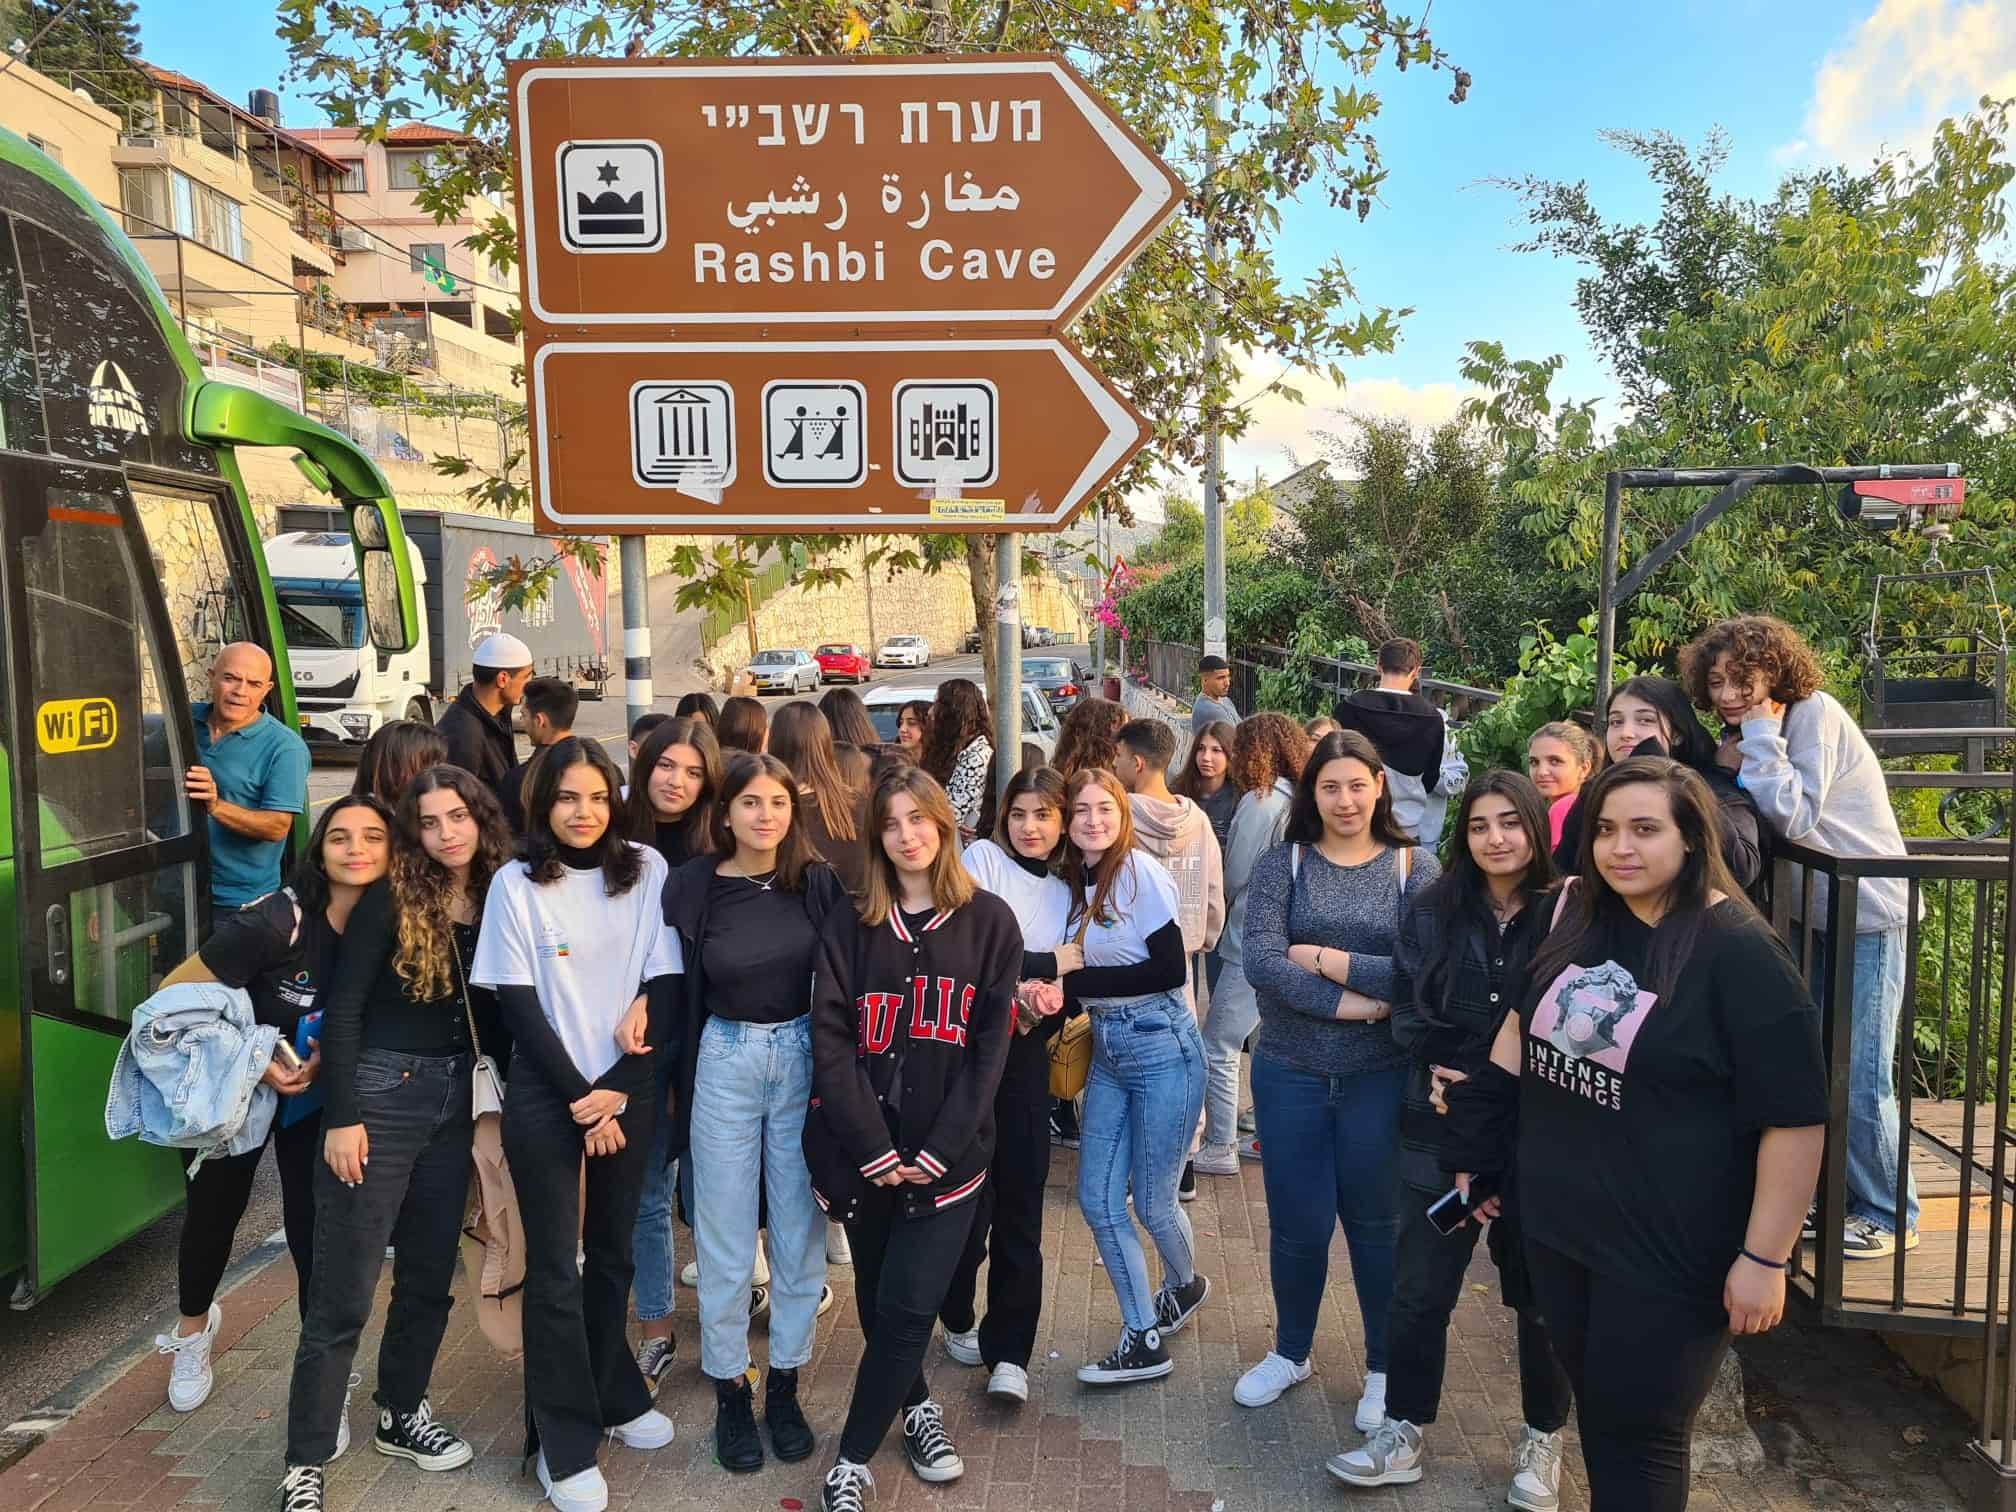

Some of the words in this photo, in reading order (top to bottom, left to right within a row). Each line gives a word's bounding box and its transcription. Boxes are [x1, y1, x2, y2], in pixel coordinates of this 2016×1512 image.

[900, 99, 1042, 144] מערת
[726, 175, 848, 234] رشبي
[881, 170, 1021, 229] مغارة
[694, 240, 885, 283] Rashbi
[919, 238, 1057, 281] Cave
[1528, 1041, 1623, 1097] INTENSE
[1529, 1057, 1621, 1112] FEELINGS
